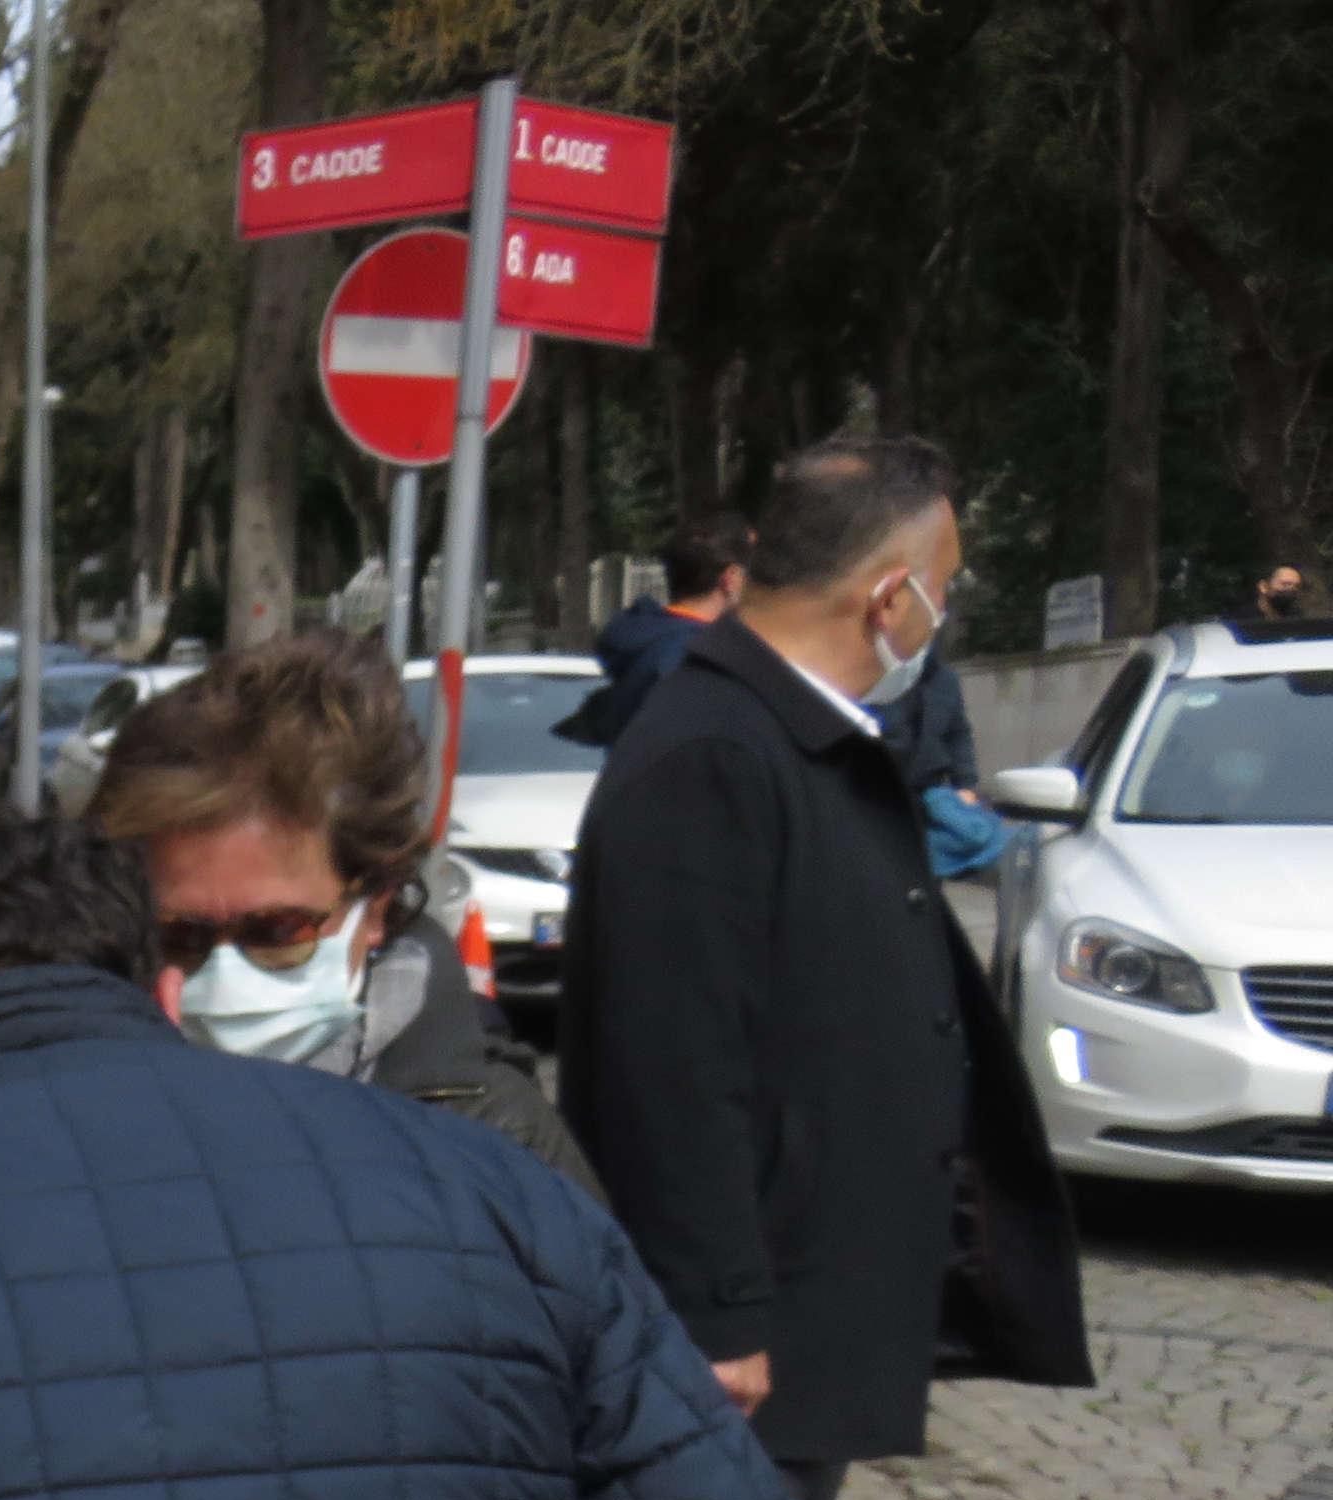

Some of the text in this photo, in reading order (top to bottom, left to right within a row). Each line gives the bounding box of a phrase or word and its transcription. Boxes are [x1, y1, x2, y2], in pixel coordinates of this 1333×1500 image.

[290, 143, 383, 186] CADDE
[540, 132, 609, 175] CADDE
[532, 252, 575, 284] ADA
